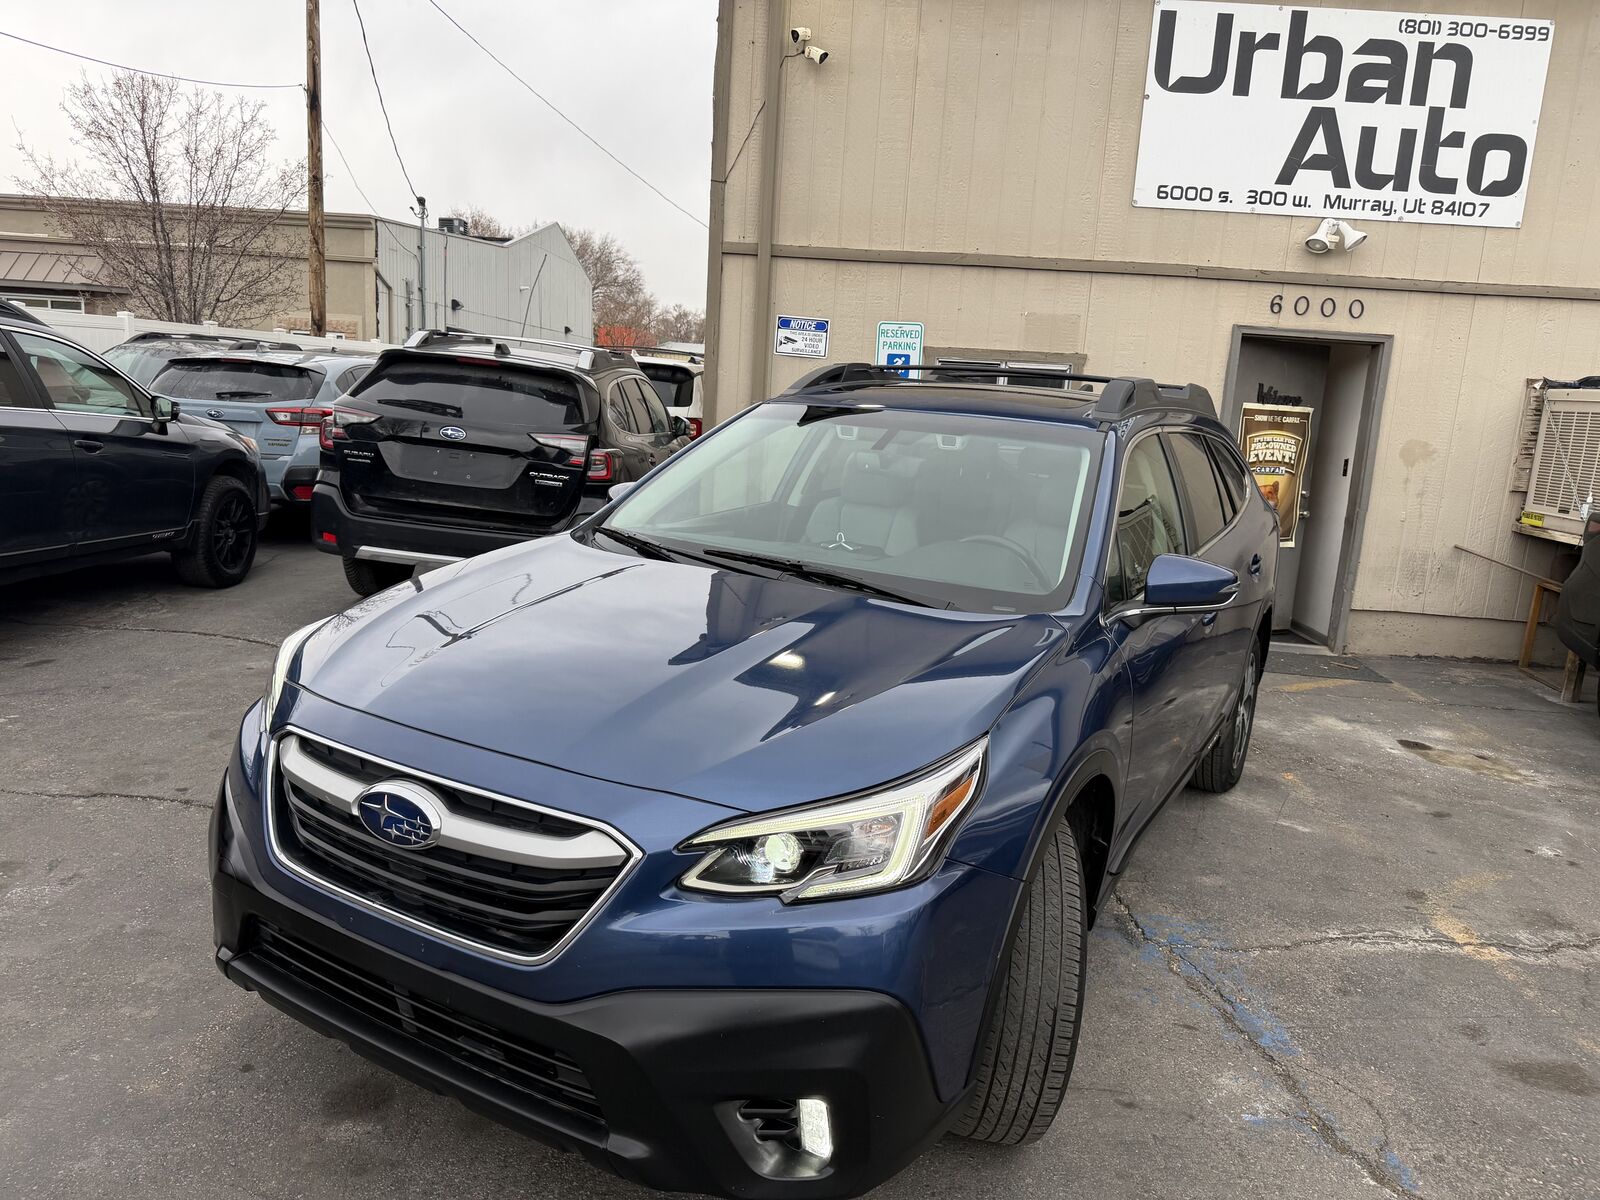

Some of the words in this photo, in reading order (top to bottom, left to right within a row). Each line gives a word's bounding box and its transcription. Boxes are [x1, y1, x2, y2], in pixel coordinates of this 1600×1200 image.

[1398, 18, 1442, 36] (801)
[1447, 21, 1550, 42] 300-6999
[1154, 9, 1474, 109] Urban
[1274, 105, 1528, 198] Auto
[1156, 184, 1213, 202] 6000
[1246, 189, 1288, 206] 300
[1323, 193, 1397, 217] Murray,
[1403, 197, 1427, 215] Ut
[1431, 199, 1491, 218] 84107
[1269, 294, 1365, 319] 6000
[790, 319, 817, 330] NOTICE
[880, 328, 920, 339] RESERVED
[882, 340, 917, 351] PARKING
[1250, 441, 1297, 452] PRE-OWNED
[1249, 450, 1296, 464] EVENT!
